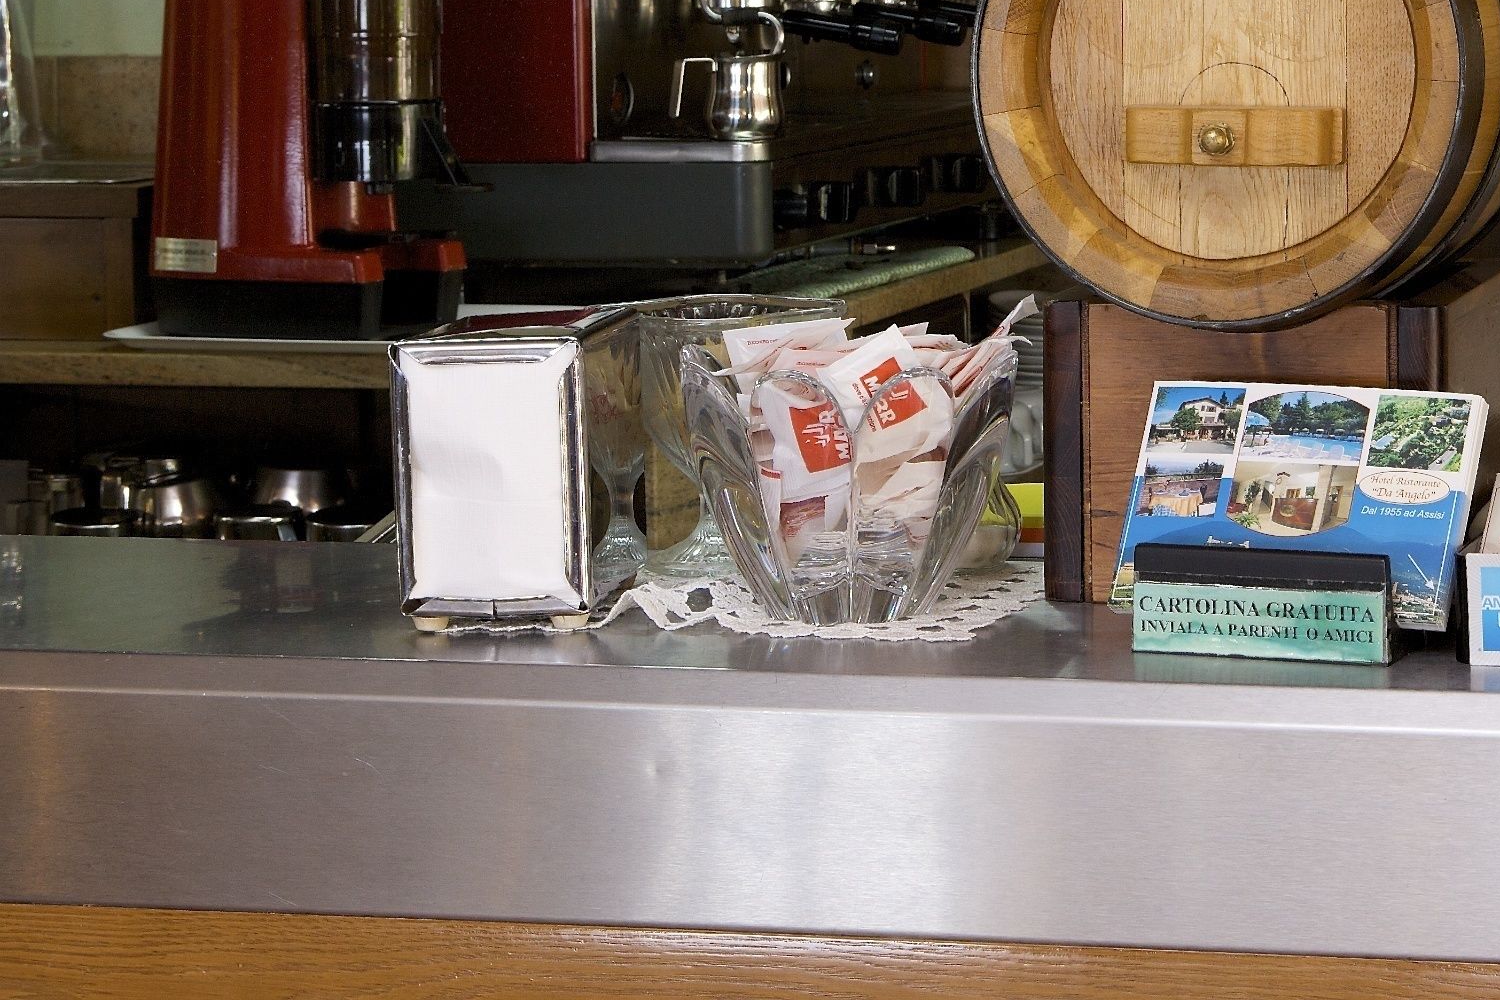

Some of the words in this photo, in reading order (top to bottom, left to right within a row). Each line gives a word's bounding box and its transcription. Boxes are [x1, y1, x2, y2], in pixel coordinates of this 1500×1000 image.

[1370, 476, 1394, 484] Hotel
[1395, 477, 1441, 488] Ristorante
[1361, 506, 1378, 515] Dal
[1380, 507, 1402, 516] 1955
[1403, 509, 1416, 517] ad
[1417, 510, 1445, 520] Assisi
[1139, 595, 1260, 618] CARTOLINA
[1266, 601, 1375, 623] GRATUITA
[1141, 620, 1208, 636] INVIALA
[1213, 624, 1224, 636] A
[1229, 624, 1298, 640] PARENTI
[1306, 628, 1318, 641] O
[1323, 629, 1374, 644] AMICI
